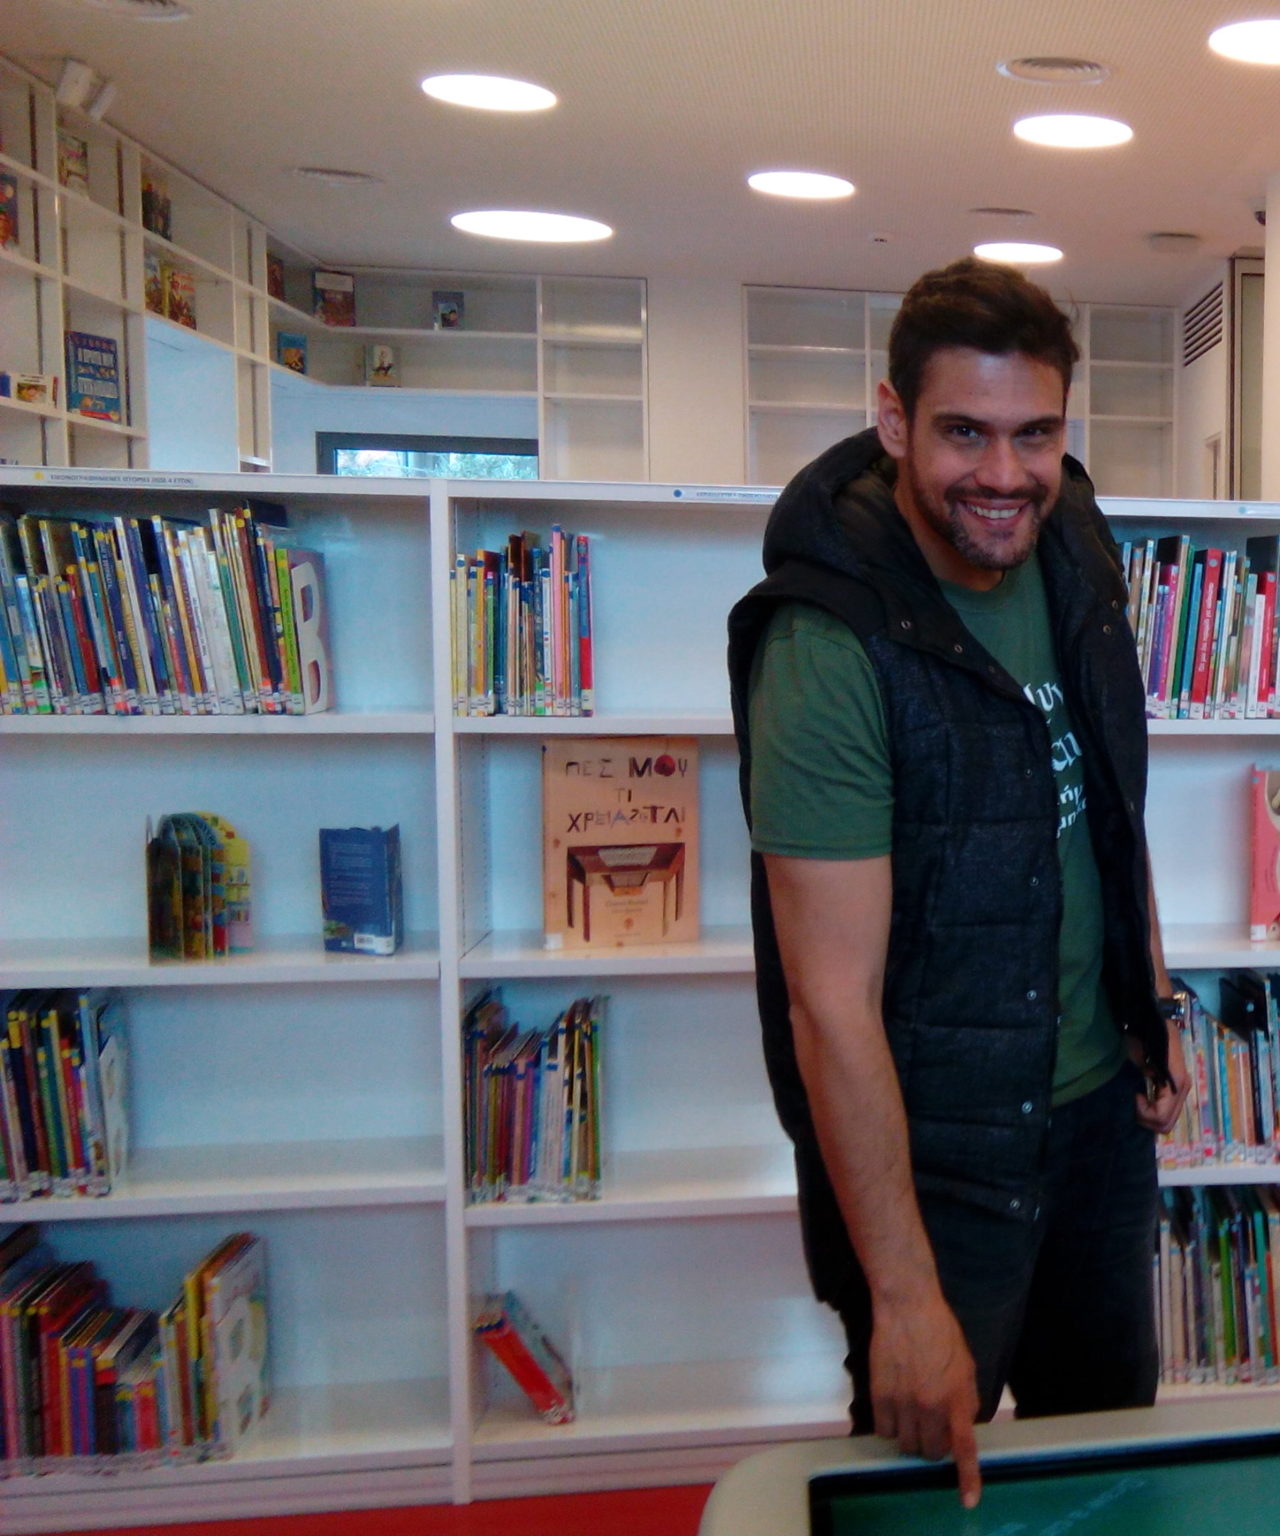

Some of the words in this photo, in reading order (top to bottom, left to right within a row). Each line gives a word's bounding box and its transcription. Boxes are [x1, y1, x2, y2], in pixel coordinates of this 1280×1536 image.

[565, 757, 614, 779] ΠΕΣ
[628, 753, 688, 779] ΜΟΥ
[615, 787, 633, 803] ΤΙ
